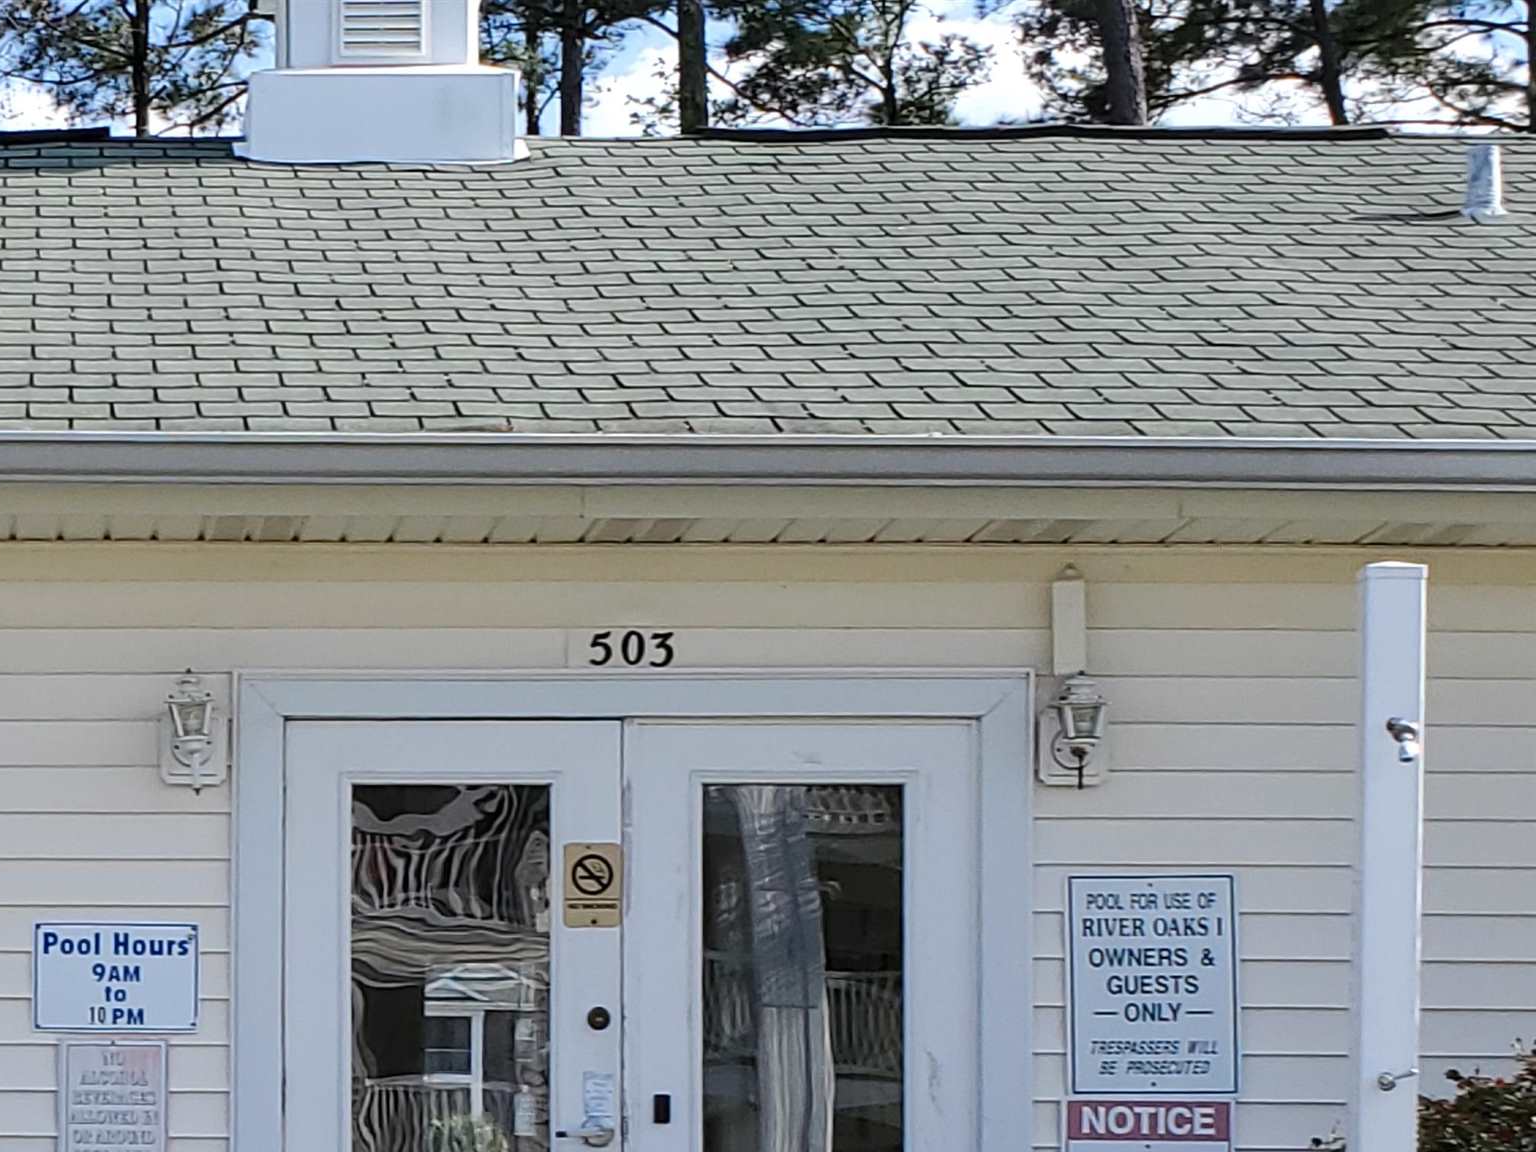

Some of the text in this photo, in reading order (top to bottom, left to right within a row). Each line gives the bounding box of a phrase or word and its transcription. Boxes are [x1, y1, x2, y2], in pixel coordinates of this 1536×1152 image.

[589, 630, 674, 668] 503
[1086, 892, 1216, 910] POOL FOR USE OF
[1082, 918, 1146, 937] RIVER
[1153, 917, 1209, 937] OAKS
[42, 932, 190, 956] Pool Hours
[1088, 948, 1216, 967] OWNERS &
[92, 963, 141, 982] 9AM
[104, 986, 127, 1002] to
[1106, 975, 1199, 994] GUESTS
[112, 1008, 145, 1025] PM
[1124, 1003, 1182, 1022] ONLY
[1090, 1040, 1218, 1055] TRESPASSERS WILL
[1099, 1060, 1211, 1076] BE PROSECUTED
[1080, 1106, 1217, 1136] NOTICE
